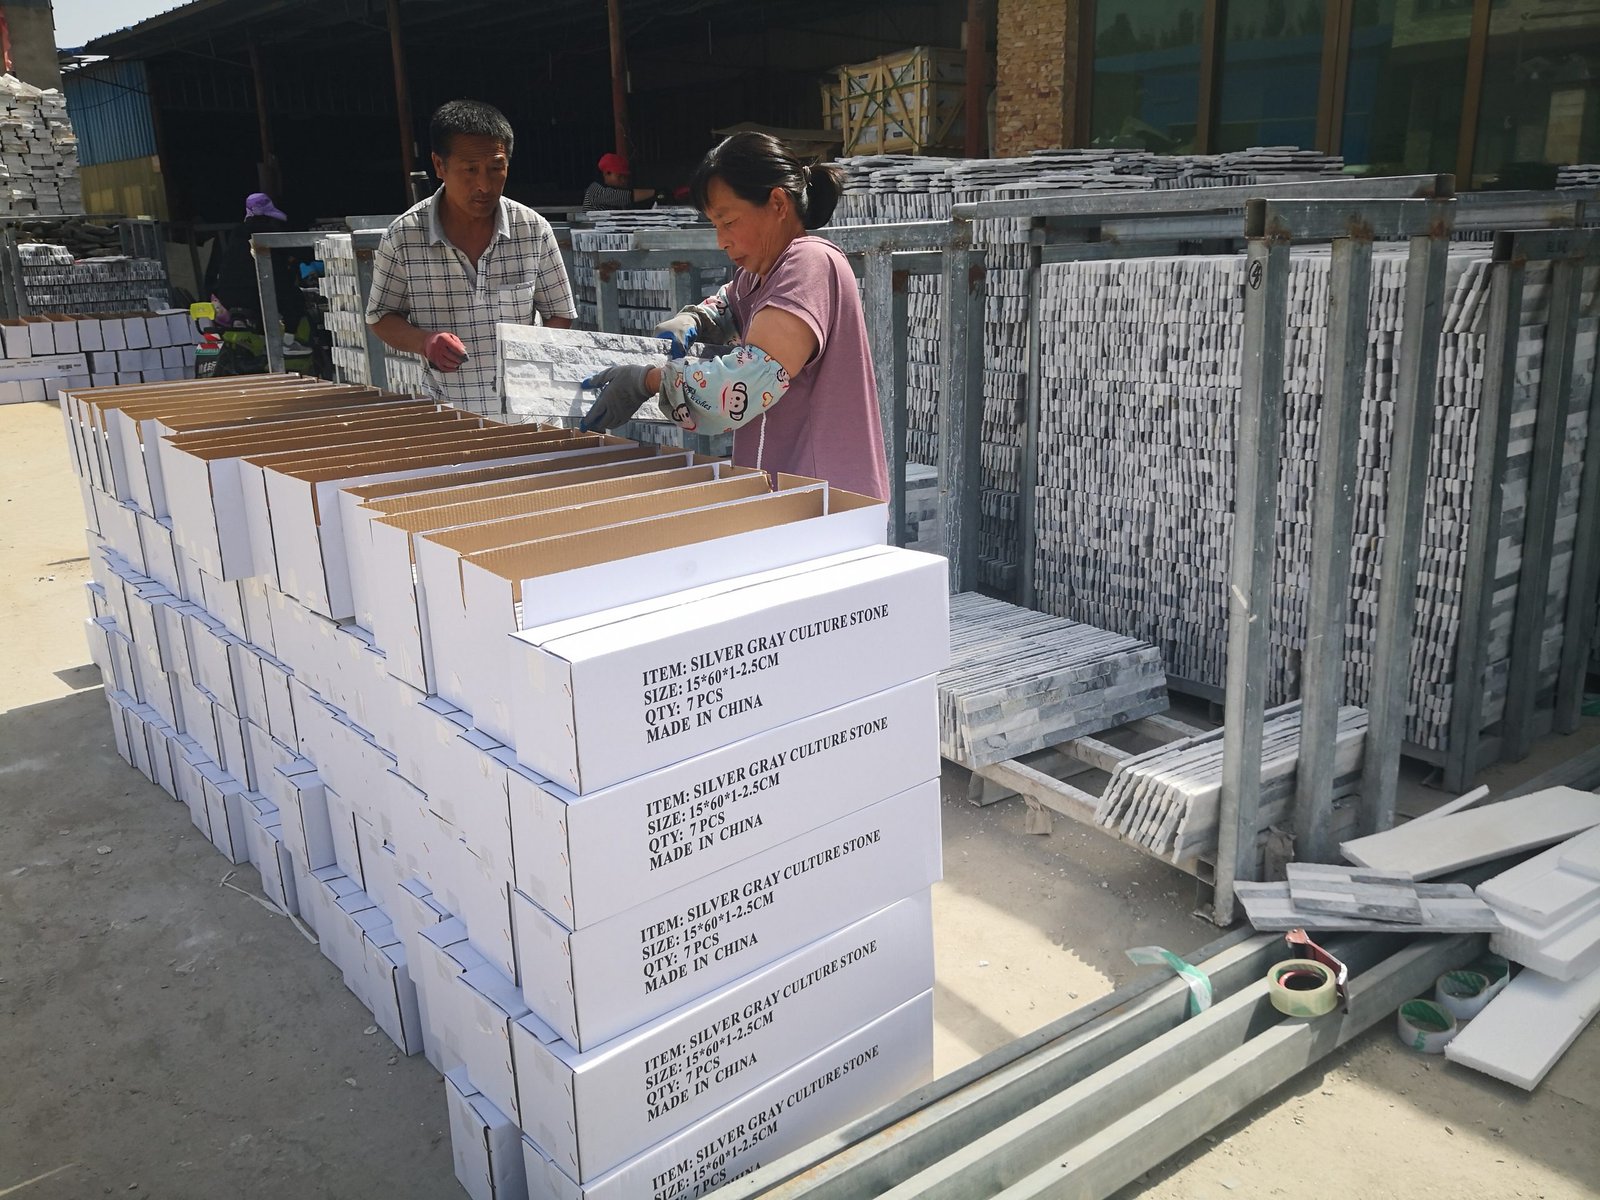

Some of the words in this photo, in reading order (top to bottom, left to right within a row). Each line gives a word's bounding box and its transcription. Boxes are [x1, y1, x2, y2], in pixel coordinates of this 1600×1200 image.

[643, 661, 687, 686] ITEM:
[691, 643, 744, 672] SILVER
[748, 632, 786, 654] GRAY
[789, 615, 847, 643] CULTURE
[850, 604, 888, 626] STONE
[644, 683, 683, 705] SIZE:
[645, 703, 680, 726] QTY:
[687, 697, 694, 711] 7
[697, 688, 723, 708] PCS
[647, 717, 690, 744] MADE
[697, 710, 712, 728] IN
[718, 694, 763, 719] CHINA
[646, 791, 690, 817] ITEM:
[694, 767, 746, 799] SILVER
[749, 752, 787, 777] GRAY
[790, 730, 847, 761] CULTURE
[850, 717, 888, 740] STONE
[648, 812, 686, 835] SIZE:
[649, 831, 683, 853] QTY:
[690, 823, 697, 836] 7
[700, 812, 725, 833] PCS
[649, 842, 693, 871] MADE
[699, 833, 714, 852] IN
[720, 814, 763, 842] CHINA
[641, 914, 684, 944] ITEM:
[688, 888, 740, 922] SILVER
[743, 871, 781, 897] GRAY
[784, 846, 841, 879] CULTURE
[843, 829, 881, 854] STONE
[642, 936, 680, 961] SIZE:
[643, 955, 678, 978] QTY:
[684, 945, 691, 958] 7
[695, 933, 720, 955] PCS
[645, 964, 688, 995] MADE
[694, 954, 709, 972] IN
[715, 933, 758, 961] CHINA
[645, 1044, 687, 1074] ITEM:
[690, 1012, 740, 1049] SILVER
[743, 990, 781, 1019] GRAY
[783, 960, 839, 998] CULTURE
[840, 940, 877, 968] STONE
[646, 1064, 682, 1091] SIZE:
[646, 1081, 680, 1106] QTY:
[687, 1070, 693, 1083] 7
[696, 1056, 720, 1081] PCS
[648, 1092, 689, 1122] MADE
[695, 1078, 710, 1096] IN
[715, 1052, 757, 1084] CHINA
[652, 1159, 693, 1191] ITEM:
[696, 1125, 745, 1164] SILVER
[748, 1100, 784, 1131] GRAY
[787, 1067, 841, 1107] CULTURE
[843, 1045, 879, 1076] STONE
[654, 1179, 690, 1200] SIZE:
[694, 1184, 701, 1197] 7
[704, 1168, 727, 1193] PCS
